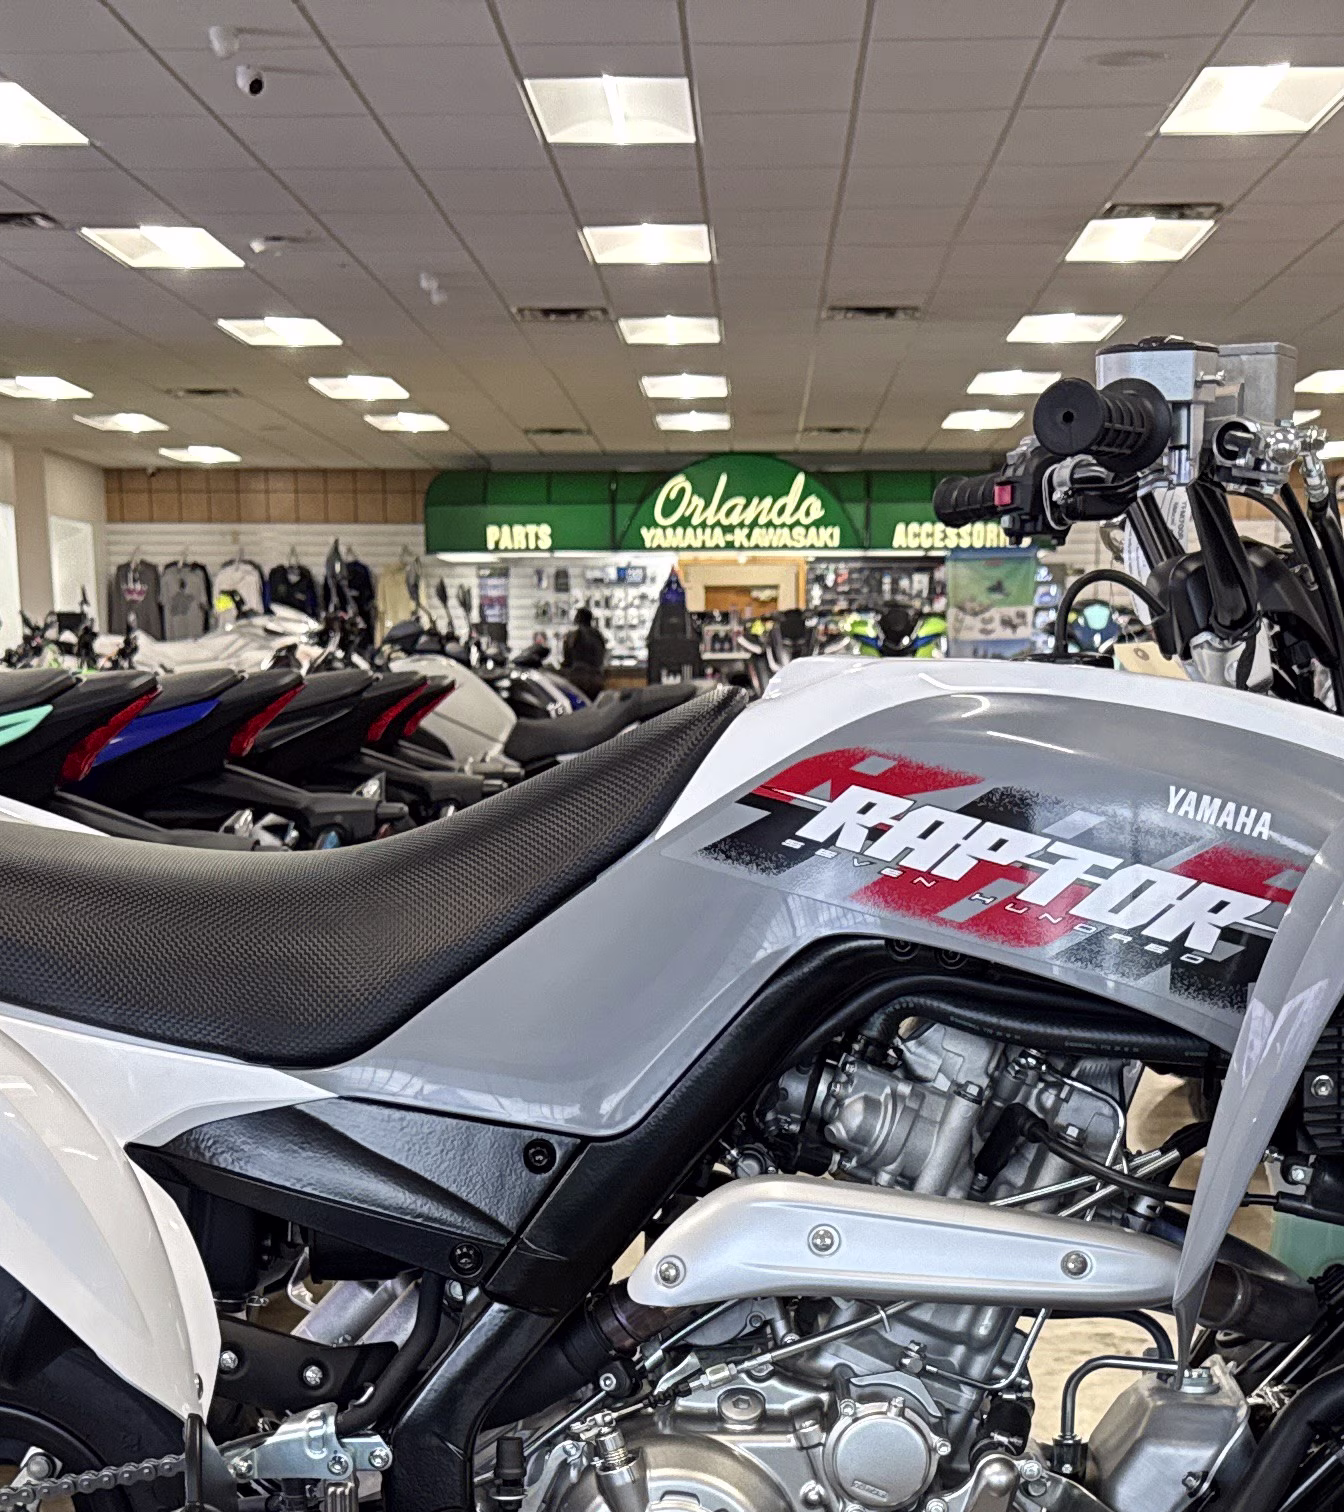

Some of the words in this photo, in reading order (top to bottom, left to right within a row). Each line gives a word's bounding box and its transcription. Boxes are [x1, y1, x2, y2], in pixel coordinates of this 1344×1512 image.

[653, 471, 826, 527] Orlando
[486, 523, 553, 551] PARTS
[640, 525, 841, 549] YAMAHA-KAWASAKI
[1166, 785, 1272, 841] YAMAHA
[794, 784, 1280, 954] RAPTOR
[781, 837, 940, 889] SEVEN
[969, 890, 1208, 964] HUNDRED
